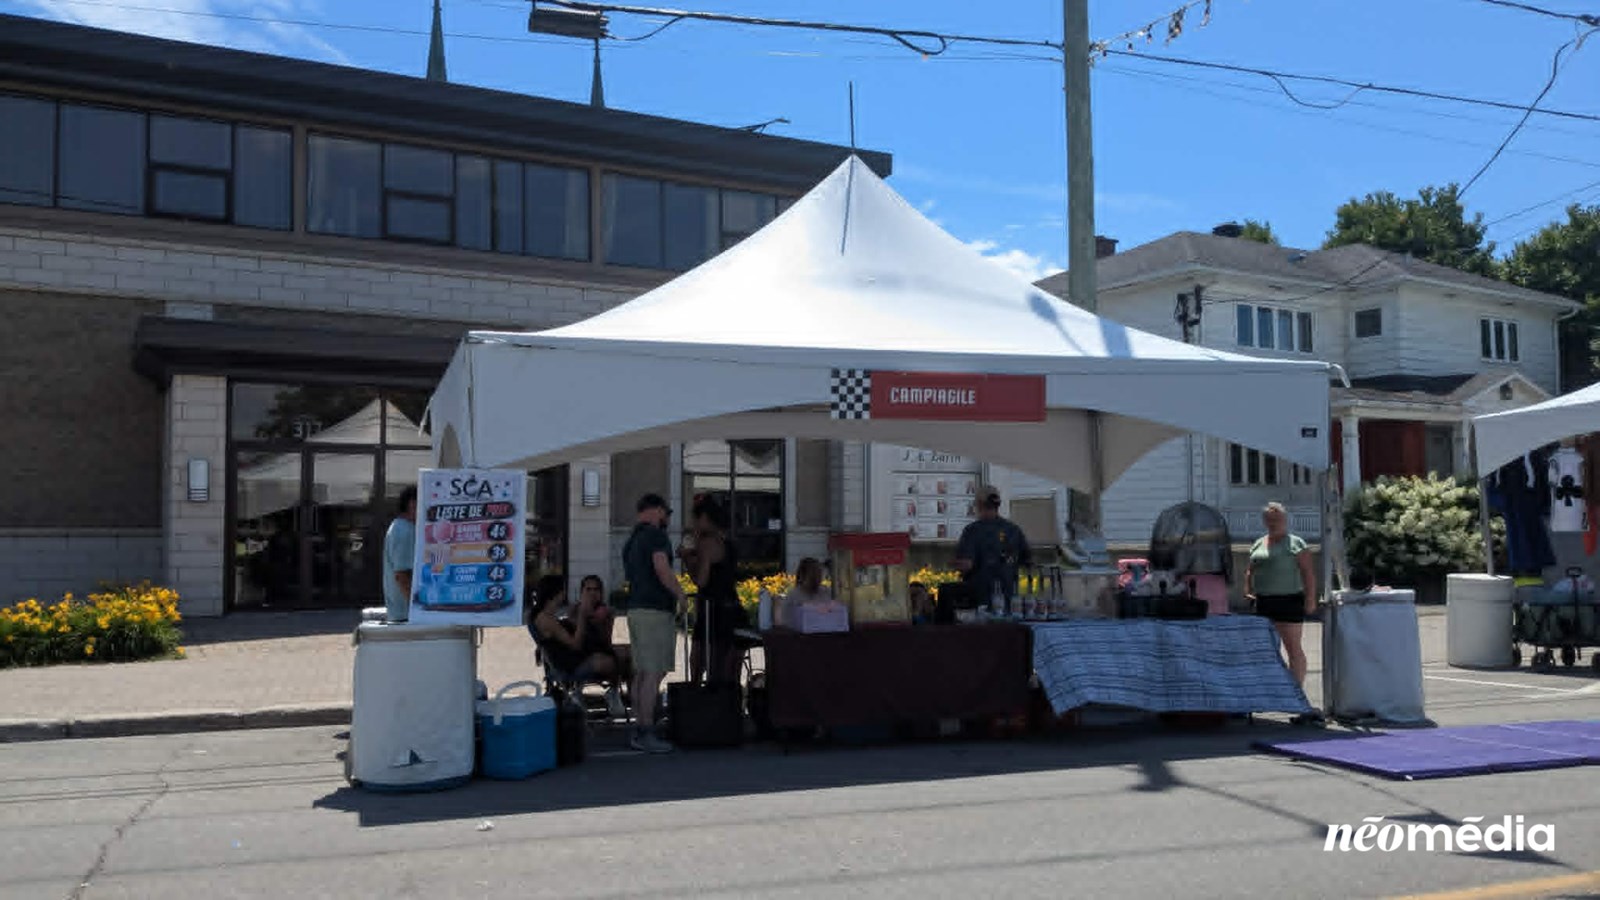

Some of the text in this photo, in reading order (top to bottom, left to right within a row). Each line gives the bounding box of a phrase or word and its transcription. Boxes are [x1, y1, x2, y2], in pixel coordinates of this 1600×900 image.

[890, 386, 976, 405] CAMPIAGILE
[450, 478, 493, 498] SCA
[436, 506, 466, 519] LISTE
[469, 504, 482, 517] DE
